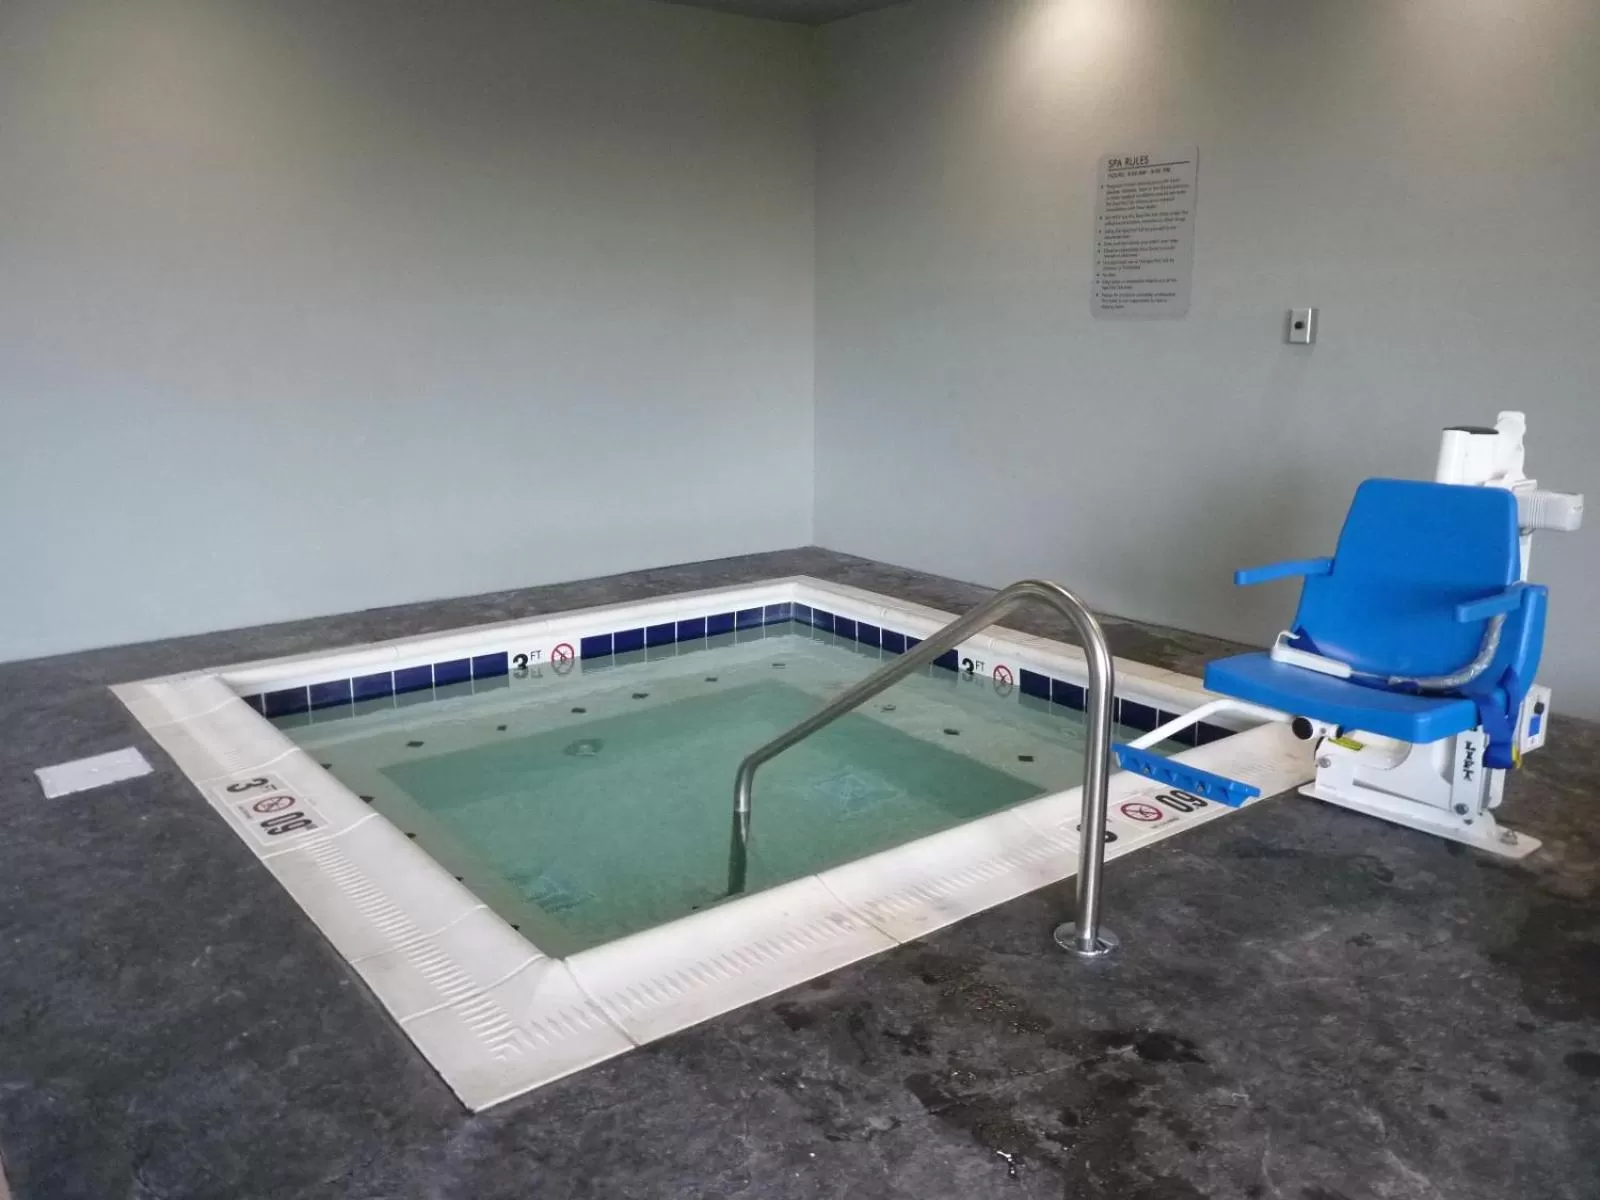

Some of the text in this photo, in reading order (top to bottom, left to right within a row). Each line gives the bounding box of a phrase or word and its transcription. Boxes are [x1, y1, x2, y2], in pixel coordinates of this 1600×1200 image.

[1107, 155, 1149, 168] SPA RULES
[530, 649, 542, 661] FT
[975, 660, 986, 672] FT
[226, 777, 269, 793] 3
